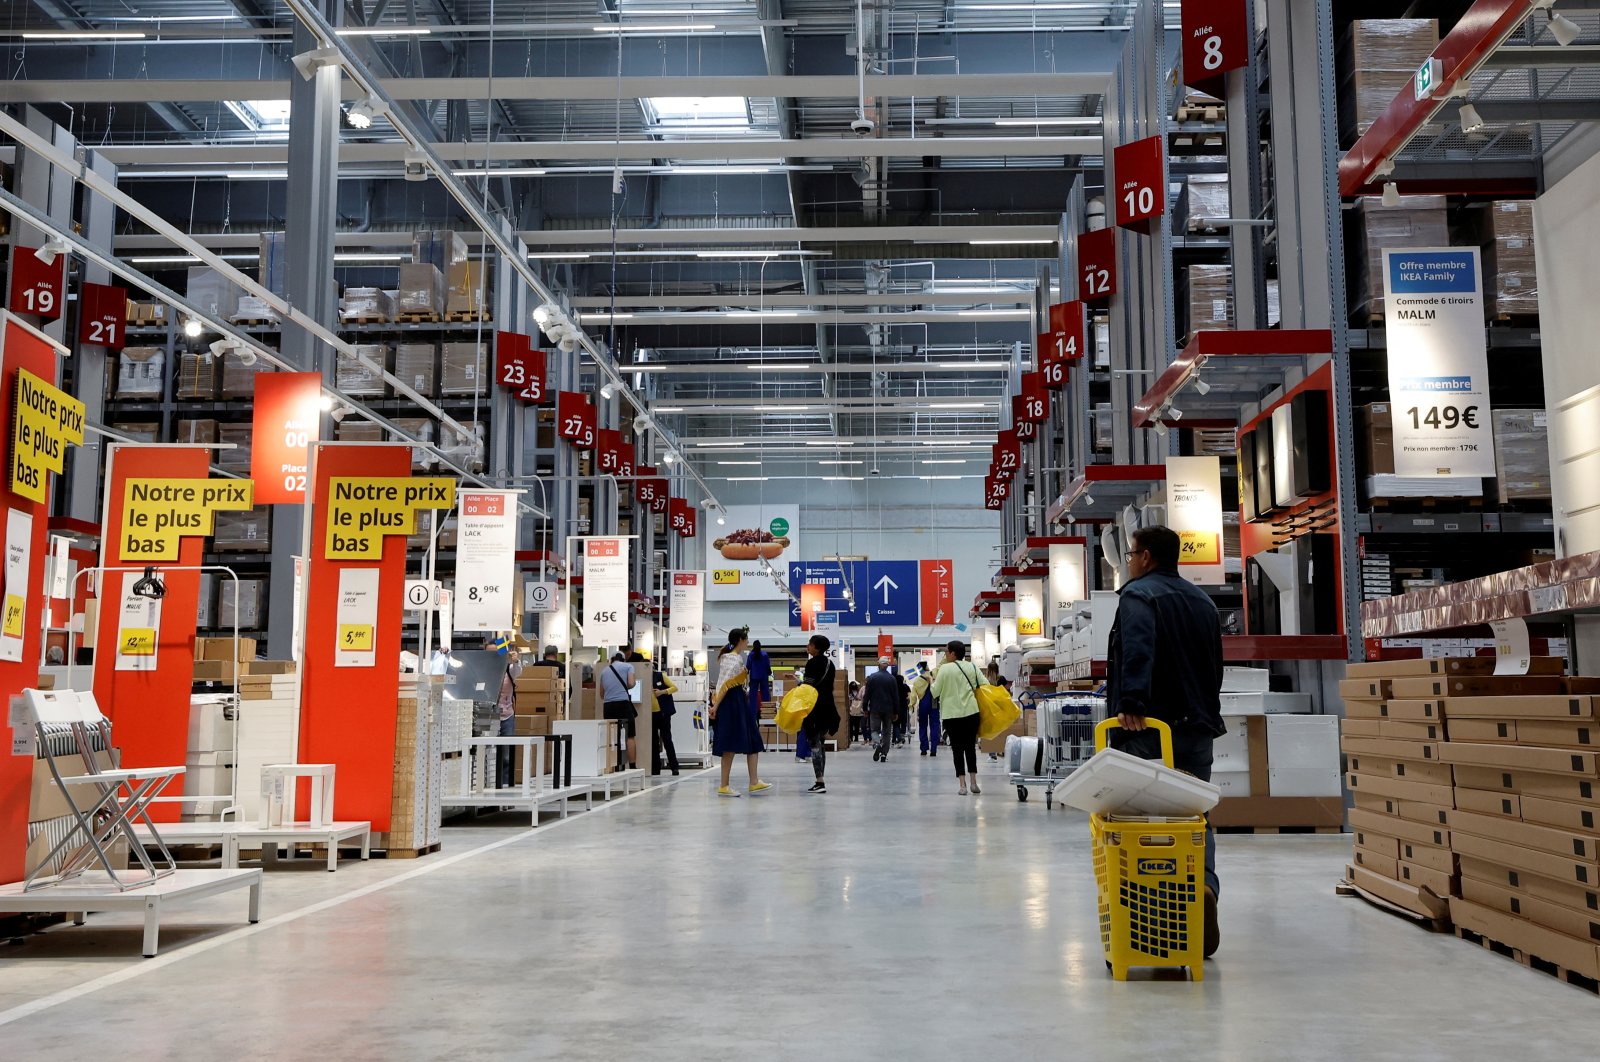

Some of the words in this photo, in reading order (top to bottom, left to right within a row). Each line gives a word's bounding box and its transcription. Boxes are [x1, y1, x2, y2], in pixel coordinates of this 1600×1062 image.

[1194, 25, 1213, 38] Allée
[1203, 35, 1223, 70] 8
[1123, 180, 1138, 190] Allée
[1124, 186, 1154, 217] 10
[1399, 261, 1424, 270] Offre
[1426, 260, 1467, 270] membre
[1085, 269, 1110, 295] 12
[1400, 272, 1422, 281] IKEA
[1424, 271, 1456, 282] Family
[23, 288, 54, 313] 19
[1396, 297, 1439, 306] Commode
[1440, 297, 1447, 305] 6
[1448, 296, 1474, 304] tiroirs
[103, 314, 117, 322] Allée
[1397, 310, 1436, 320] MALM
[89, 320, 116, 344] 21
[1056, 335, 1077, 358] 14
[503, 364, 525, 384] 23
[1043, 363, 1062, 383] 16
[520, 382, 541, 399] 25
[1424, 380, 1472, 390] membre
[22, 378, 57, 420] Notre
[60, 404, 82, 434] prix
[1026, 400, 1043, 418] 18
[1406, 405, 1480, 430] 149€
[564, 420, 583, 436] 27
[1016, 422, 1033, 437] 20
[19, 415, 30, 446] le
[34, 426, 58, 460] plus
[285, 432, 309, 448] 00
[1460, 444, 1478, 452] 179€
[282, 464, 308, 472] Place
[602, 454, 617, 468] 31
[1002, 453, 1016, 468] 22
[16, 454, 39, 489] bas
[284, 475, 307, 492] 02
[993, 484, 1006, 497] 26
[132, 484, 195, 502] Notre
[202, 484, 246, 507] prix
[336, 482, 398, 500] Notre
[404, 482, 446, 506] prix
[640, 488, 654, 500] 35
[654, 498, 666, 510] 37
[129, 509, 148, 527] le
[155, 509, 201, 532] plus
[334, 508, 352, 526] le
[360, 508, 404, 532] plus
[673, 516, 685, 527] 39
[127, 534, 165, 553] bas
[332, 534, 368, 552] bas
[594, 612, 617, 622] 45€
[1141, 862, 1174, 870] IKEA
